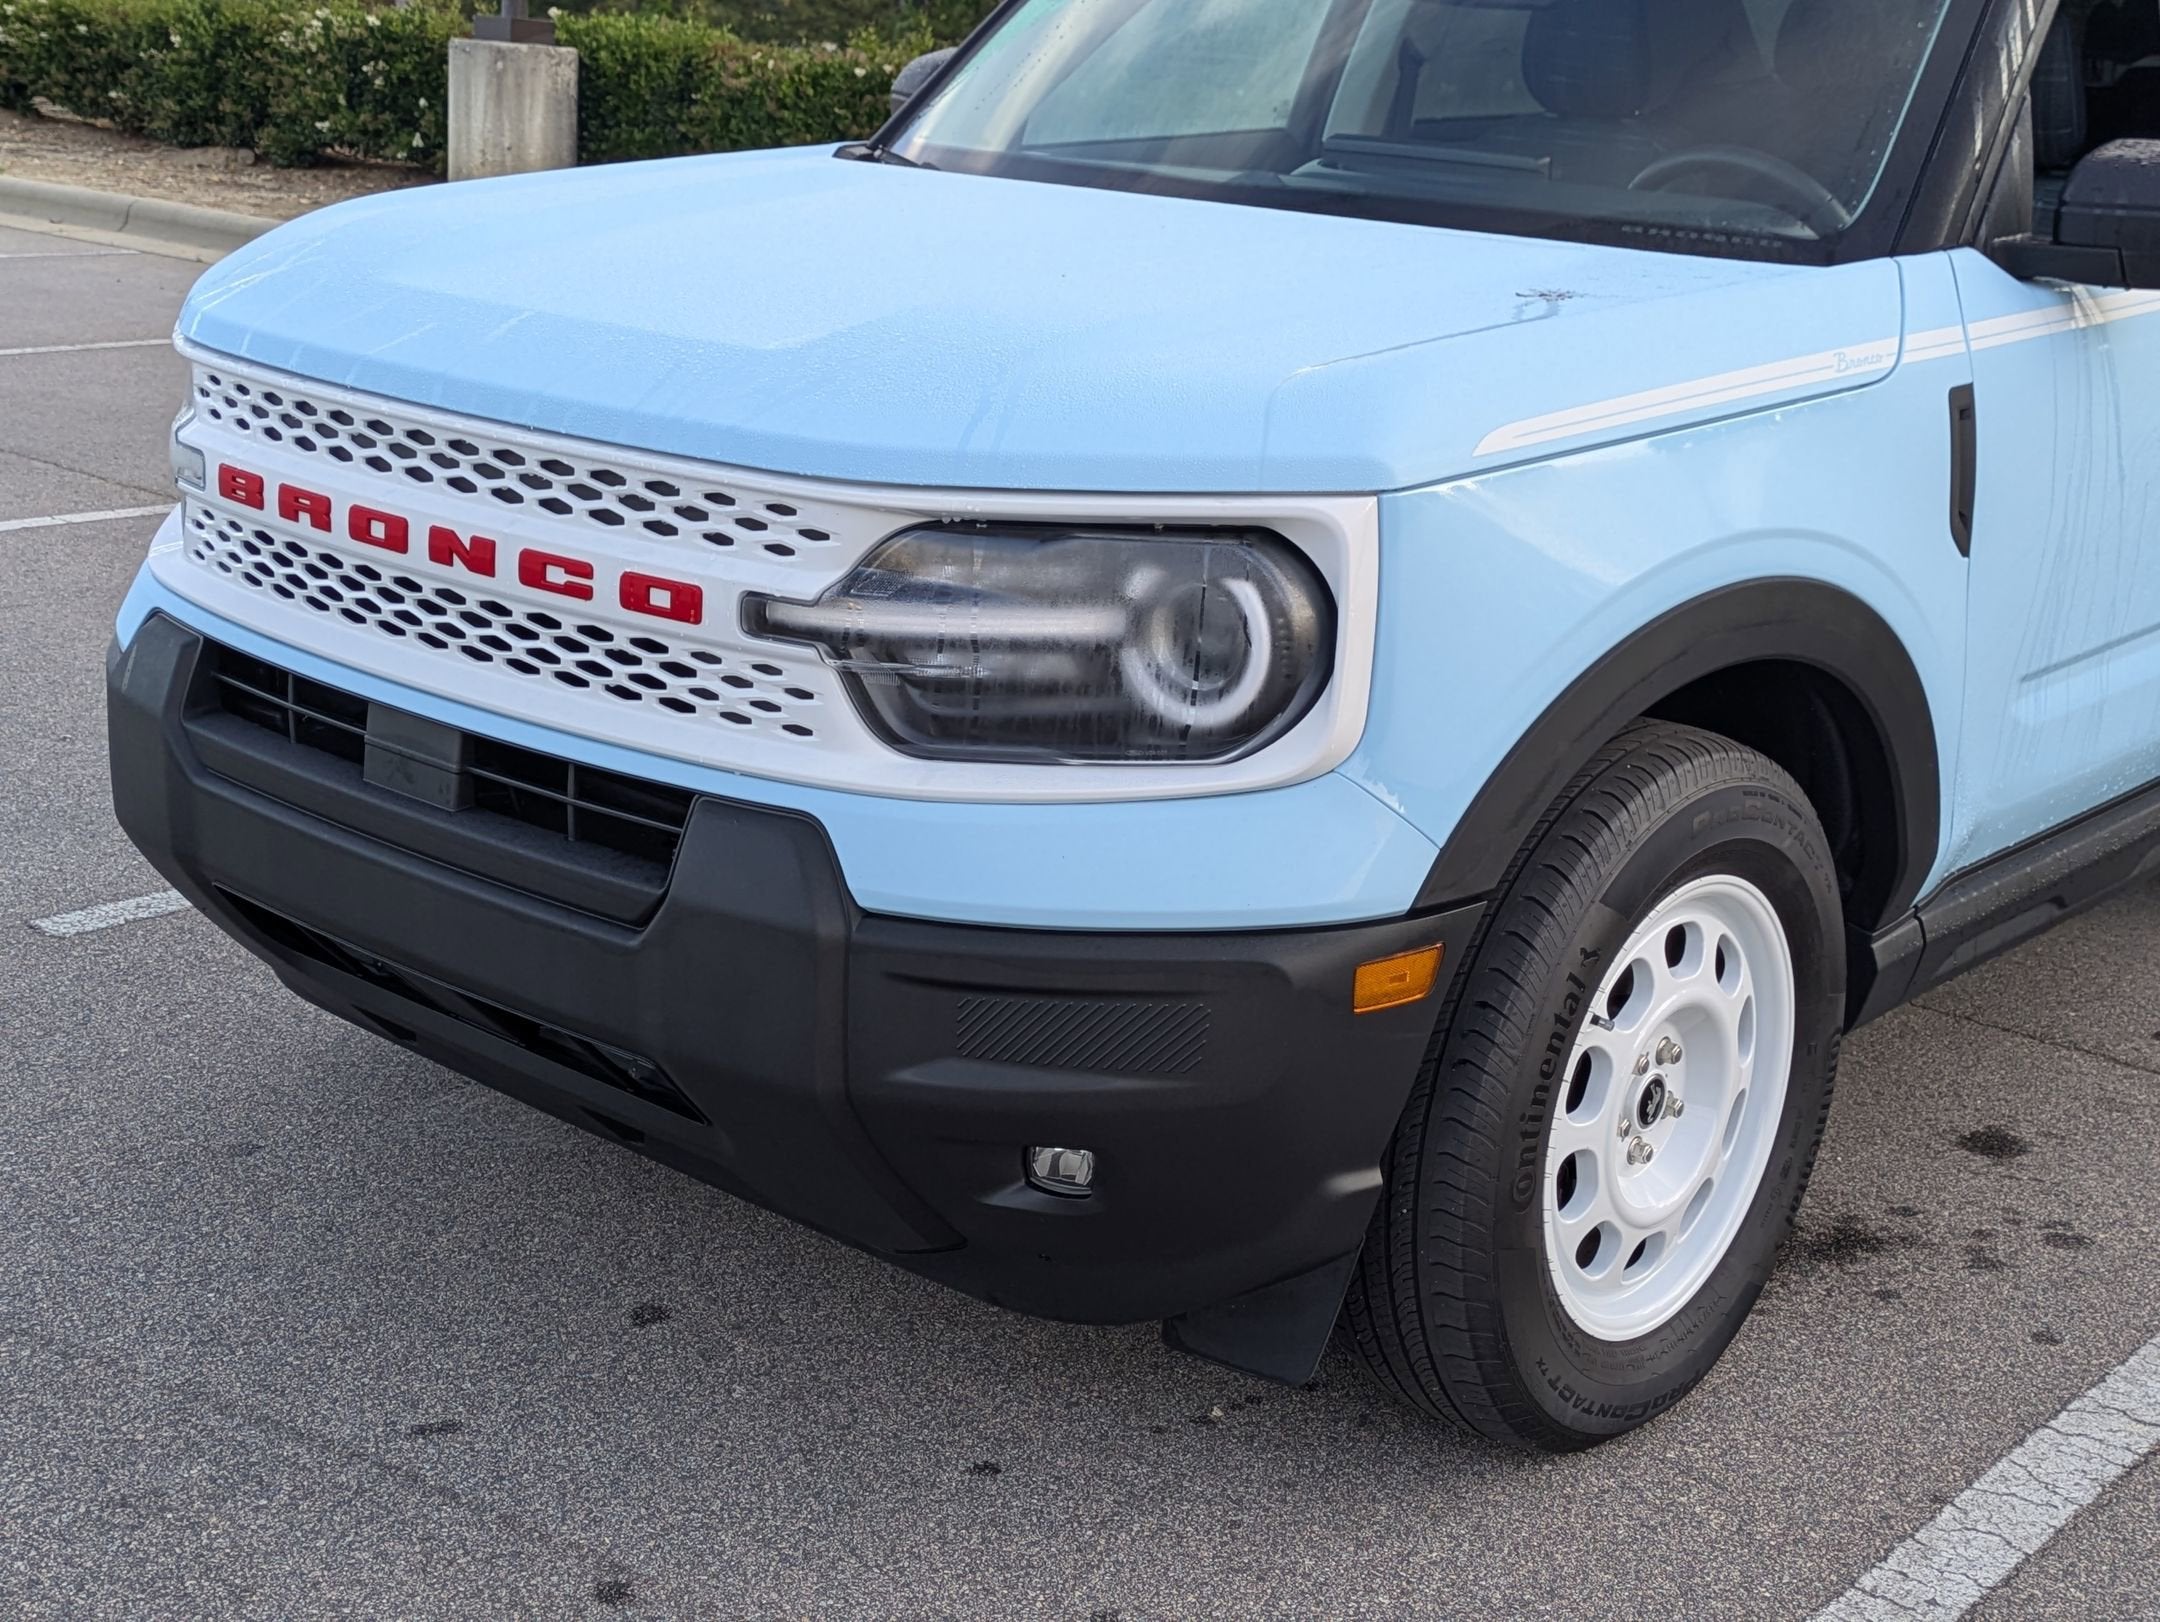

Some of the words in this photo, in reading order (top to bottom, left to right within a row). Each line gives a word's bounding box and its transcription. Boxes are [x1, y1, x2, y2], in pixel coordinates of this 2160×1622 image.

[1833, 350, 1884, 374] Bronco
[218, 463, 704, 625] BRONCO
[1510, 971, 1586, 1214] Continental
